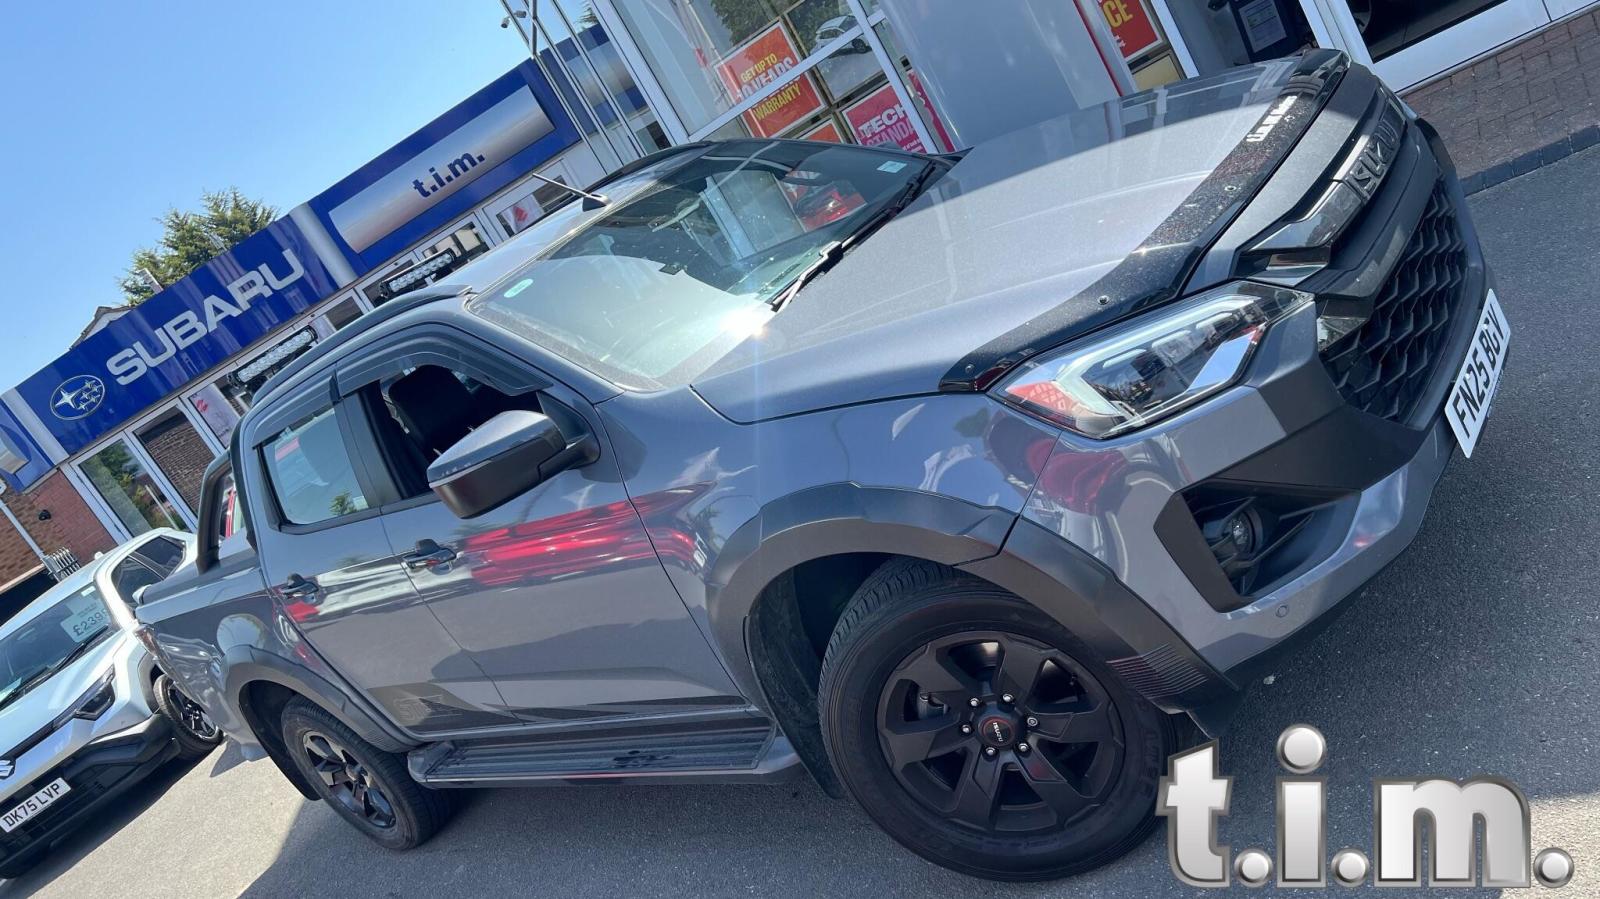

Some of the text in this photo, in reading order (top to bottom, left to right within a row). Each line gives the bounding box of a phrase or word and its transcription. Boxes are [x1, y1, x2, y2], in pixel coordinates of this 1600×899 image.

[740, 53, 777, 82] GET UP TO
[752, 82, 801, 119] WARRANTY
[412, 153, 486, 197] t.i.m.
[106, 249, 304, 385] SUBARU
[1452, 303, 1504, 438] FN25 BGV
[992, 722, 1003, 742] ISUZU
[3, 783, 60, 827] DK75 LVP
